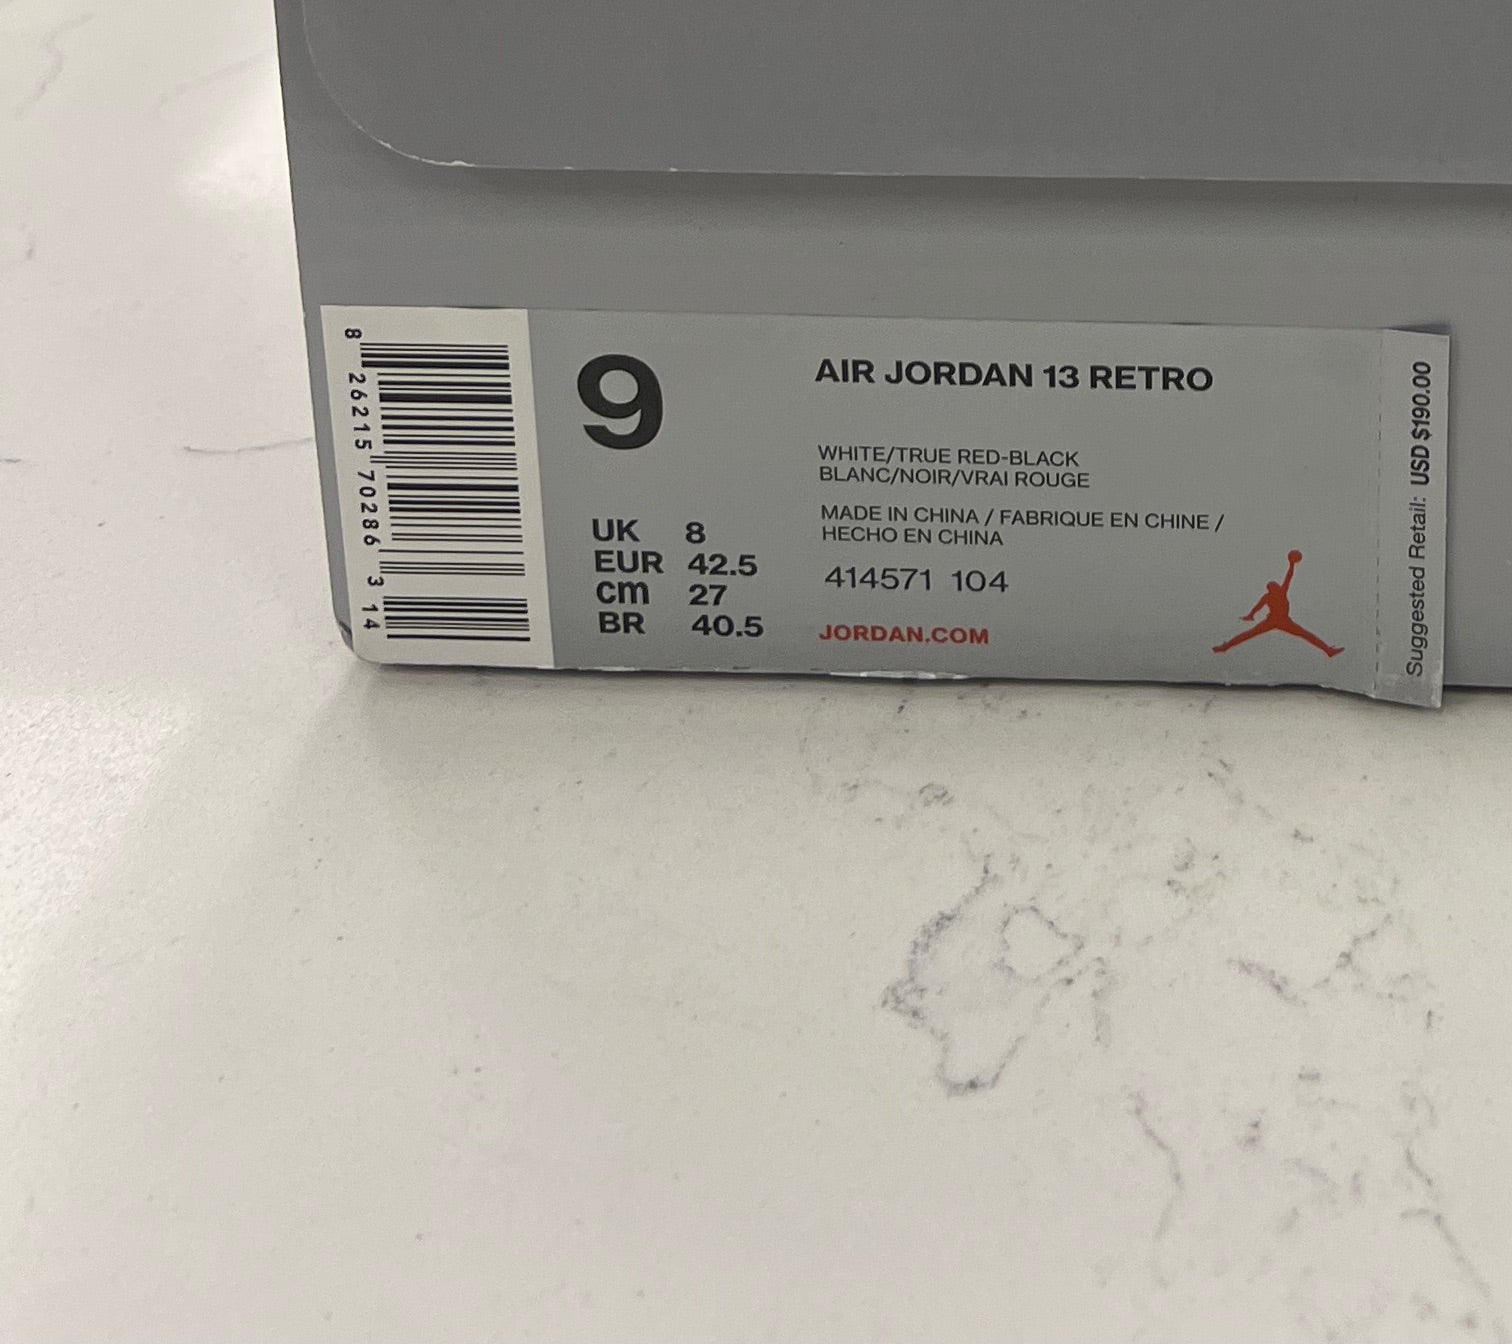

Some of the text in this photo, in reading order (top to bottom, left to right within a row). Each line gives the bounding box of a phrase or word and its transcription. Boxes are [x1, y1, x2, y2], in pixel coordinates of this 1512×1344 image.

[814, 358, 1214, 391] AIR JORDAN 13 RETRO
[577, 353, 663, 450] 9
[818, 445, 1079, 467] WHITE/TRUE RED-BLACK
[819, 466, 1090, 488] BLANC/NOIR/VRAI ROUGE
[592, 518, 706, 544] UK 8
[821, 505, 1225, 533] MADE IN CHINA / FABRIQUE EN CHINE /
[1406, 361, 1432, 676] Suggested Retail: USD $190.00
[822, 526, 1003, 546] HECHO EN CHINA
[594, 550, 758, 576] EUR 42.5
[825, 567, 1008, 593] 414571 104
[596, 581, 728, 606] cm 27
[599, 612, 764, 638] BR 40.5
[819, 624, 989, 645] JORDAN.COM
